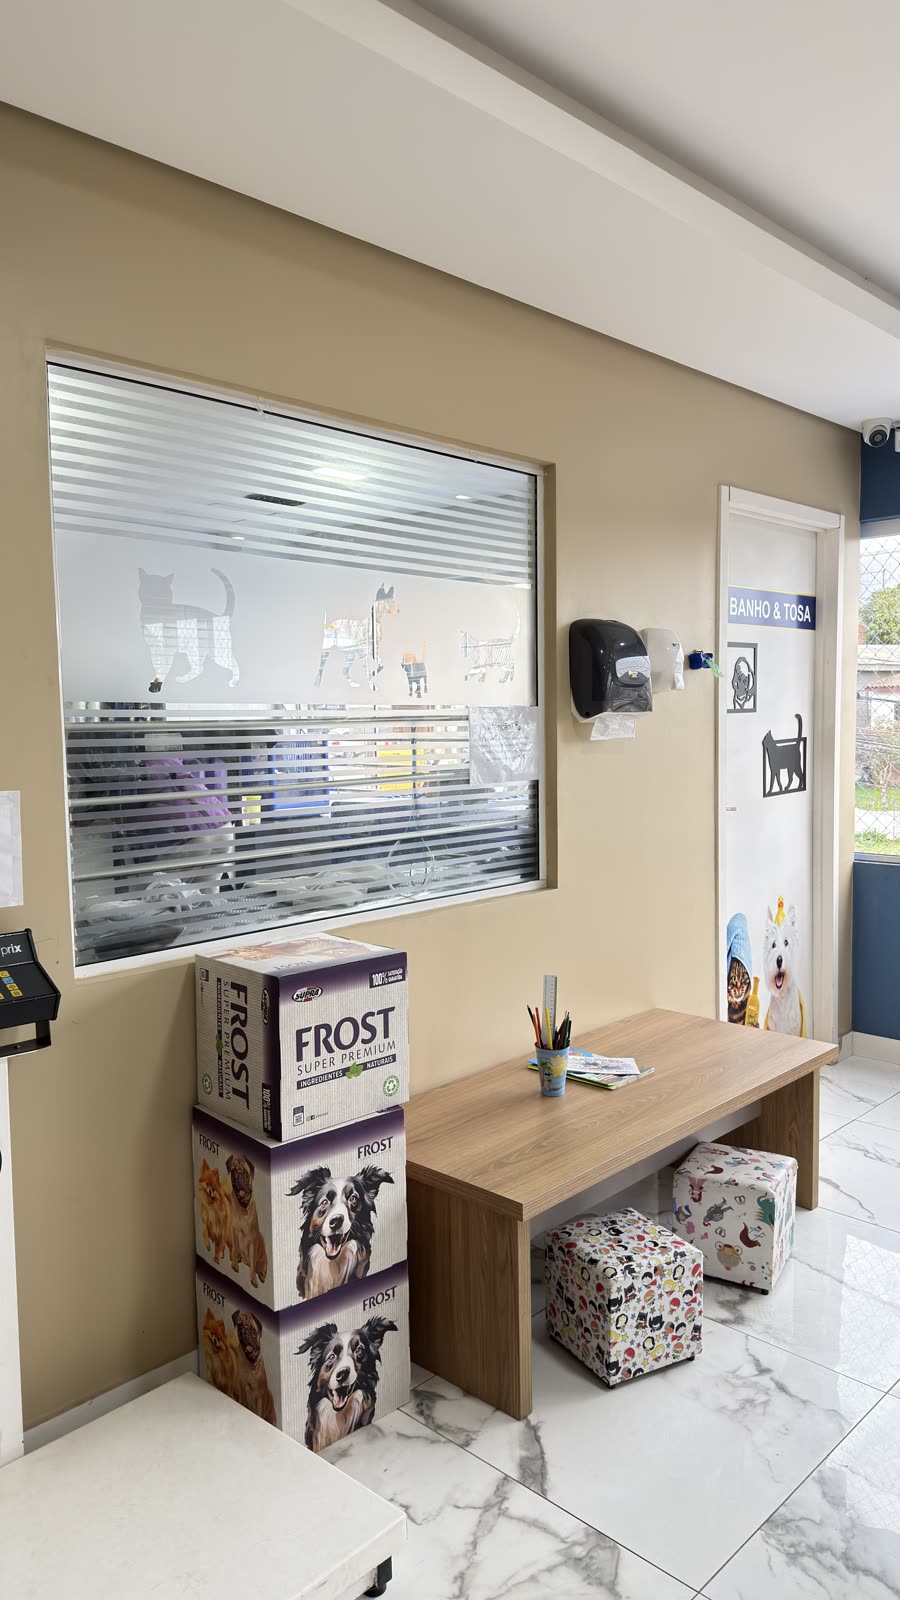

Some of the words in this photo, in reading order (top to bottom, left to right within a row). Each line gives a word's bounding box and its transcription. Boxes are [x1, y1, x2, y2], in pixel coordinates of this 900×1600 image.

[729, 597, 770, 619] BANHO
[773, 602, 781, 620] &
[784, 603, 811, 622] TOSA
[0, 943, 22, 957] prix
[372, 971, 388, 987] 100%
[294, 988, 320, 1001] SUPRA
[230, 981, 250, 1110] FROST
[295, 1006, 396, 1062] FROST
[224, 1031, 232, 1100] PREMIUM
[297, 1056, 336, 1076] SUPER
[341, 1040, 396, 1063] PREMIUM
[300, 1070, 343, 1088] INGREDIENTES
[366, 1055, 394, 1069] NATURAIS
[199, 1134, 220, 1155] FROST
[357, 1136, 393, 1159] FROST
[203, 1282, 225, 1307] FROST
[362, 1285, 397, 1311] FROST
